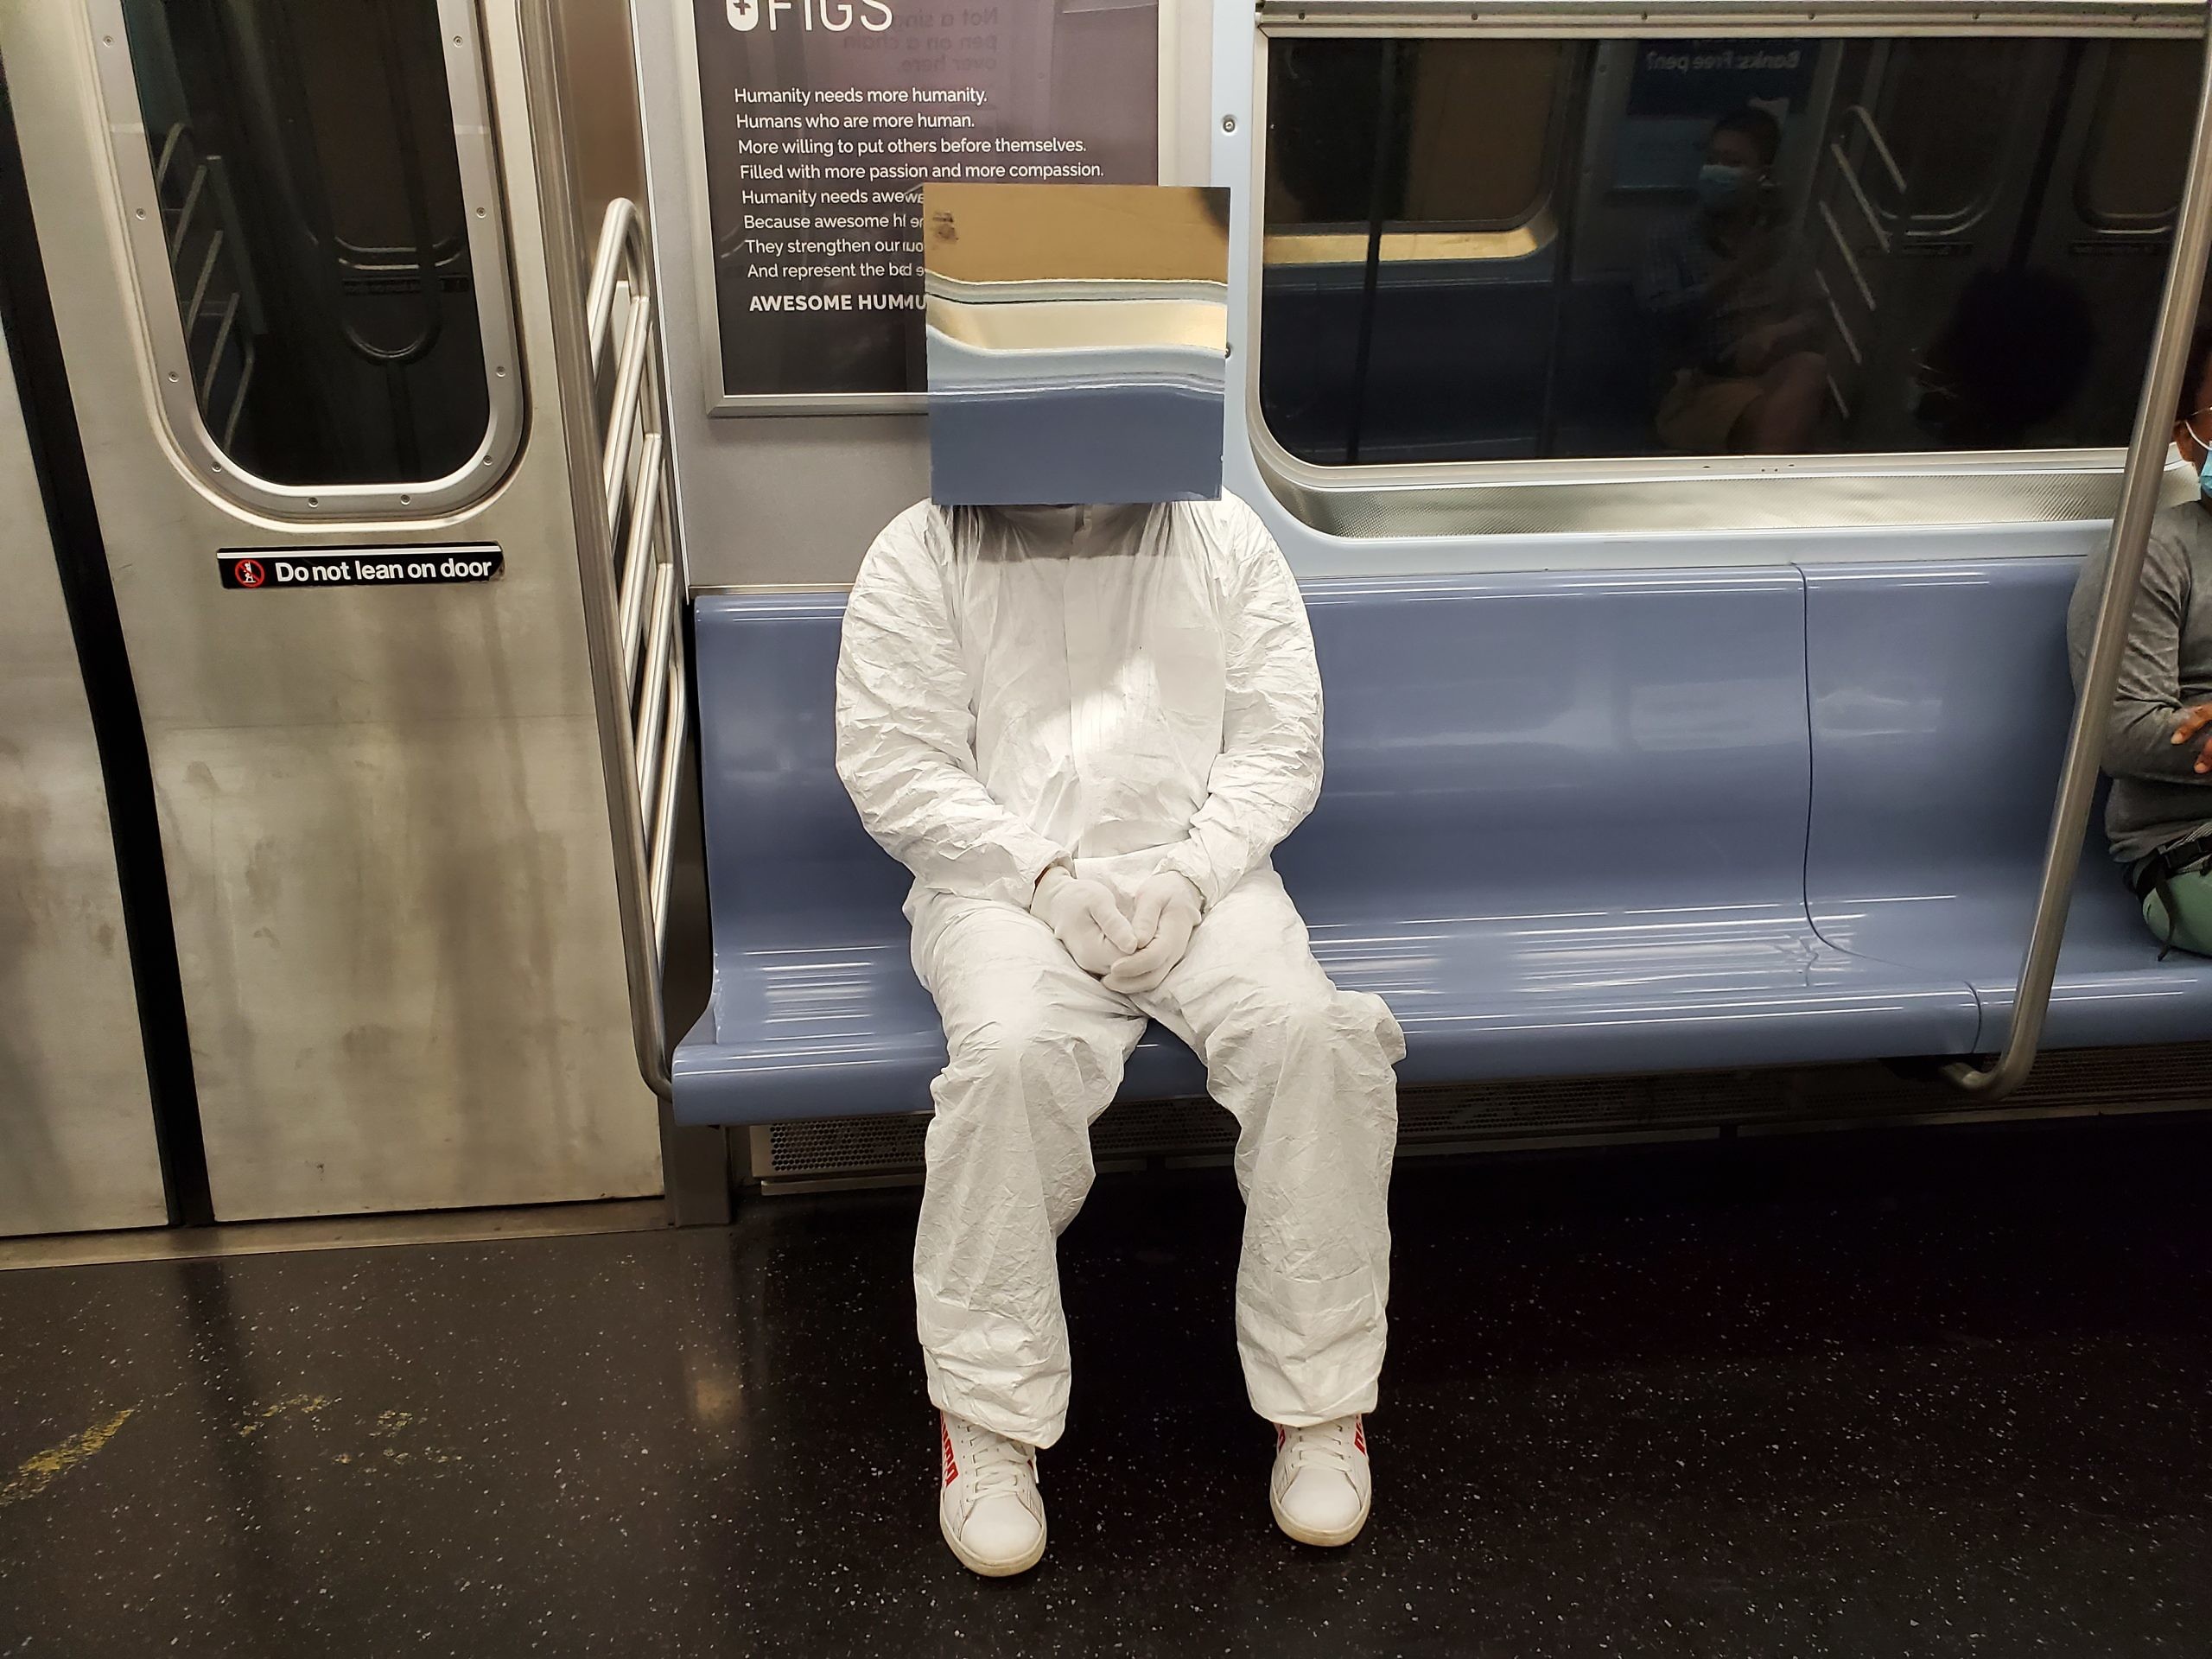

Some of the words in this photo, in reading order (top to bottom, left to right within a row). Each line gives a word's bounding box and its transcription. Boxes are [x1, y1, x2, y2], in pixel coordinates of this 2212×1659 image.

[766, 0, 892, 31] FIGS
[734, 87, 811, 106] Humanity
[815, 87, 864, 103] needs
[868, 90, 909, 103] more
[912, 86, 988, 105] humanity.
[736, 113, 802, 129] Humans
[804, 113, 840, 129] who
[843, 116, 869, 128] are
[873, 116, 914, 128] more
[918, 112, 975, 128] human.
[738, 139, 779, 155] More
[781, 138, 834, 157] willing
[837, 139, 854, 154] to
[857, 139, 885, 157] put
[888, 138, 938, 153] others
[941, 137, 992, 153] before
[995, 137, 1087, 152] themselves.
[741, 163, 784, 180] Filled
[786, 163, 821, 179] with
[824, 167, 866, 179] more
[869, 163, 928, 182] passion
[932, 162, 962, 178] and
[964, 165, 1006, 178] more
[1009, 162, 1104, 181] compassion.
[741, 189, 817, 207] Humanity
[820, 188, 868, 204] needs
[872, 191, 905, 204] awe
[744, 214, 811, 229] Because
[814, 216, 890, 229] awesome
[745, 238, 784, 257] They
[787, 238, 871, 257] strengthen
[875, 241, 900, 253] our
[747, 263, 779, 278] And
[782, 263, 856, 281] represent
[860, 262, 885, 276] the
[749, 296, 853, 312] AWESOME
[858, 295, 905, 311] HUM
[275, 563, 309, 582] Do
[313, 562, 351, 581] not
[354, 560, 404, 579] lean
[407, 563, 436, 578] on
[440, 558, 493, 577] door
